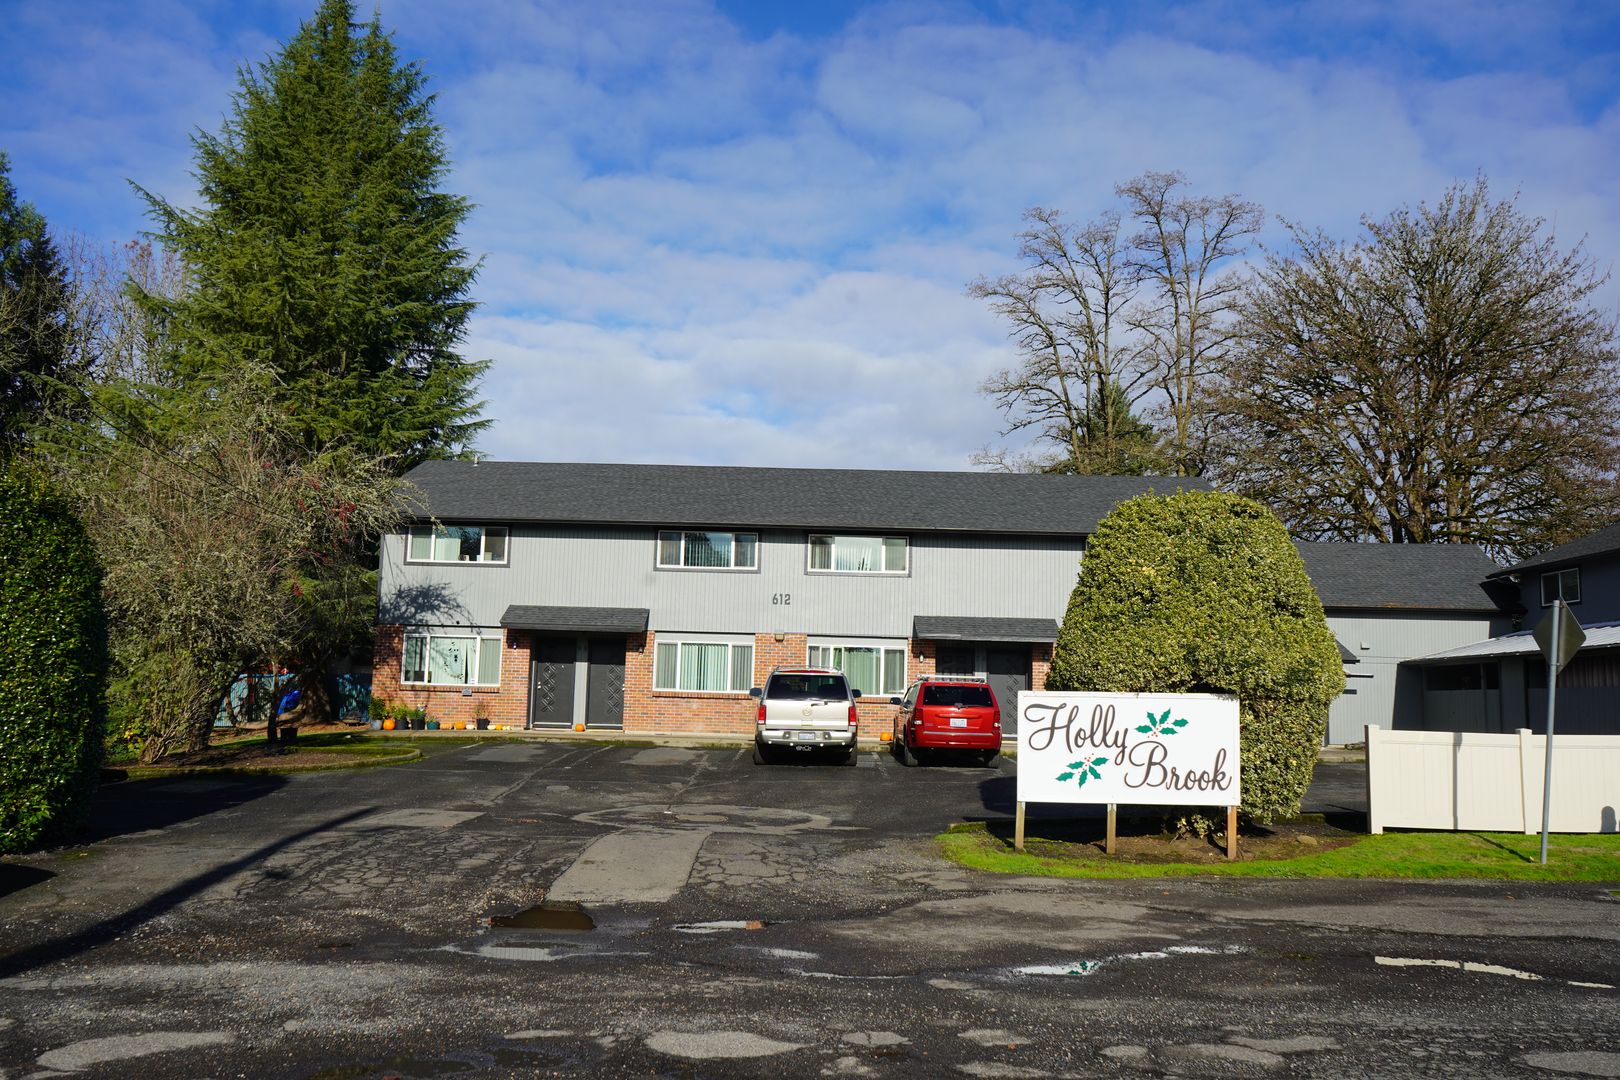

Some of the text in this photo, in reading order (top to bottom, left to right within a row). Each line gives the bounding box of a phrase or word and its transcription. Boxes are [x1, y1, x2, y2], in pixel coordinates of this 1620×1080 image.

[772, 593, 791, 606] 612
[1024, 702, 1129, 766] Holly
[1124, 740, 1233, 792] Brook
